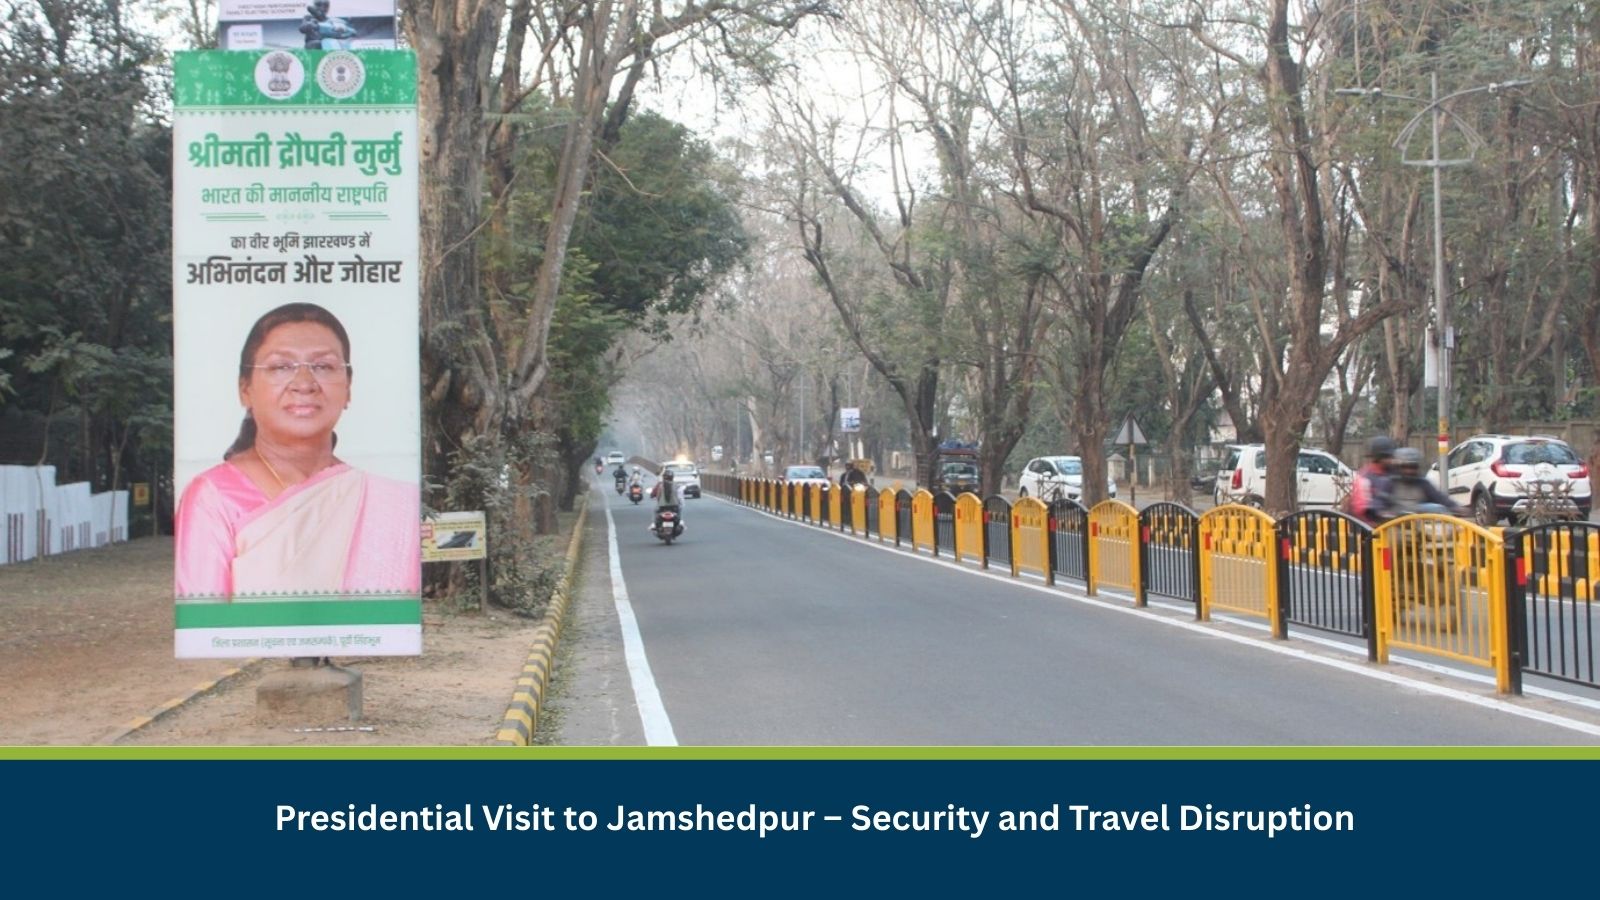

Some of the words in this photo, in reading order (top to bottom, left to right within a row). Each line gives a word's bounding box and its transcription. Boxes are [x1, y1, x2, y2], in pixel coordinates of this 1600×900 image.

[187, 132, 272, 168] श्रीमती
[276, 131, 347, 169] द्रौपदी
[351, 131, 403, 176] मुर्मु
[202, 187, 241, 204] भारत
[246, 183, 265, 203] की
[269, 181, 332, 203] माननीय
[336, 181, 388, 206] राष्ट्रपति
[230, 236, 246, 250] का
[250, 232, 270, 250] वीर
[273, 231, 300, 253] भूमि
[302, 235, 356, 250] झारखण्ड
[359, 231, 373, 249] में
[187, 255, 288, 285] अभिनंदन
[294, 254, 335, 284] और
[338, 254, 403, 284] जोहार
